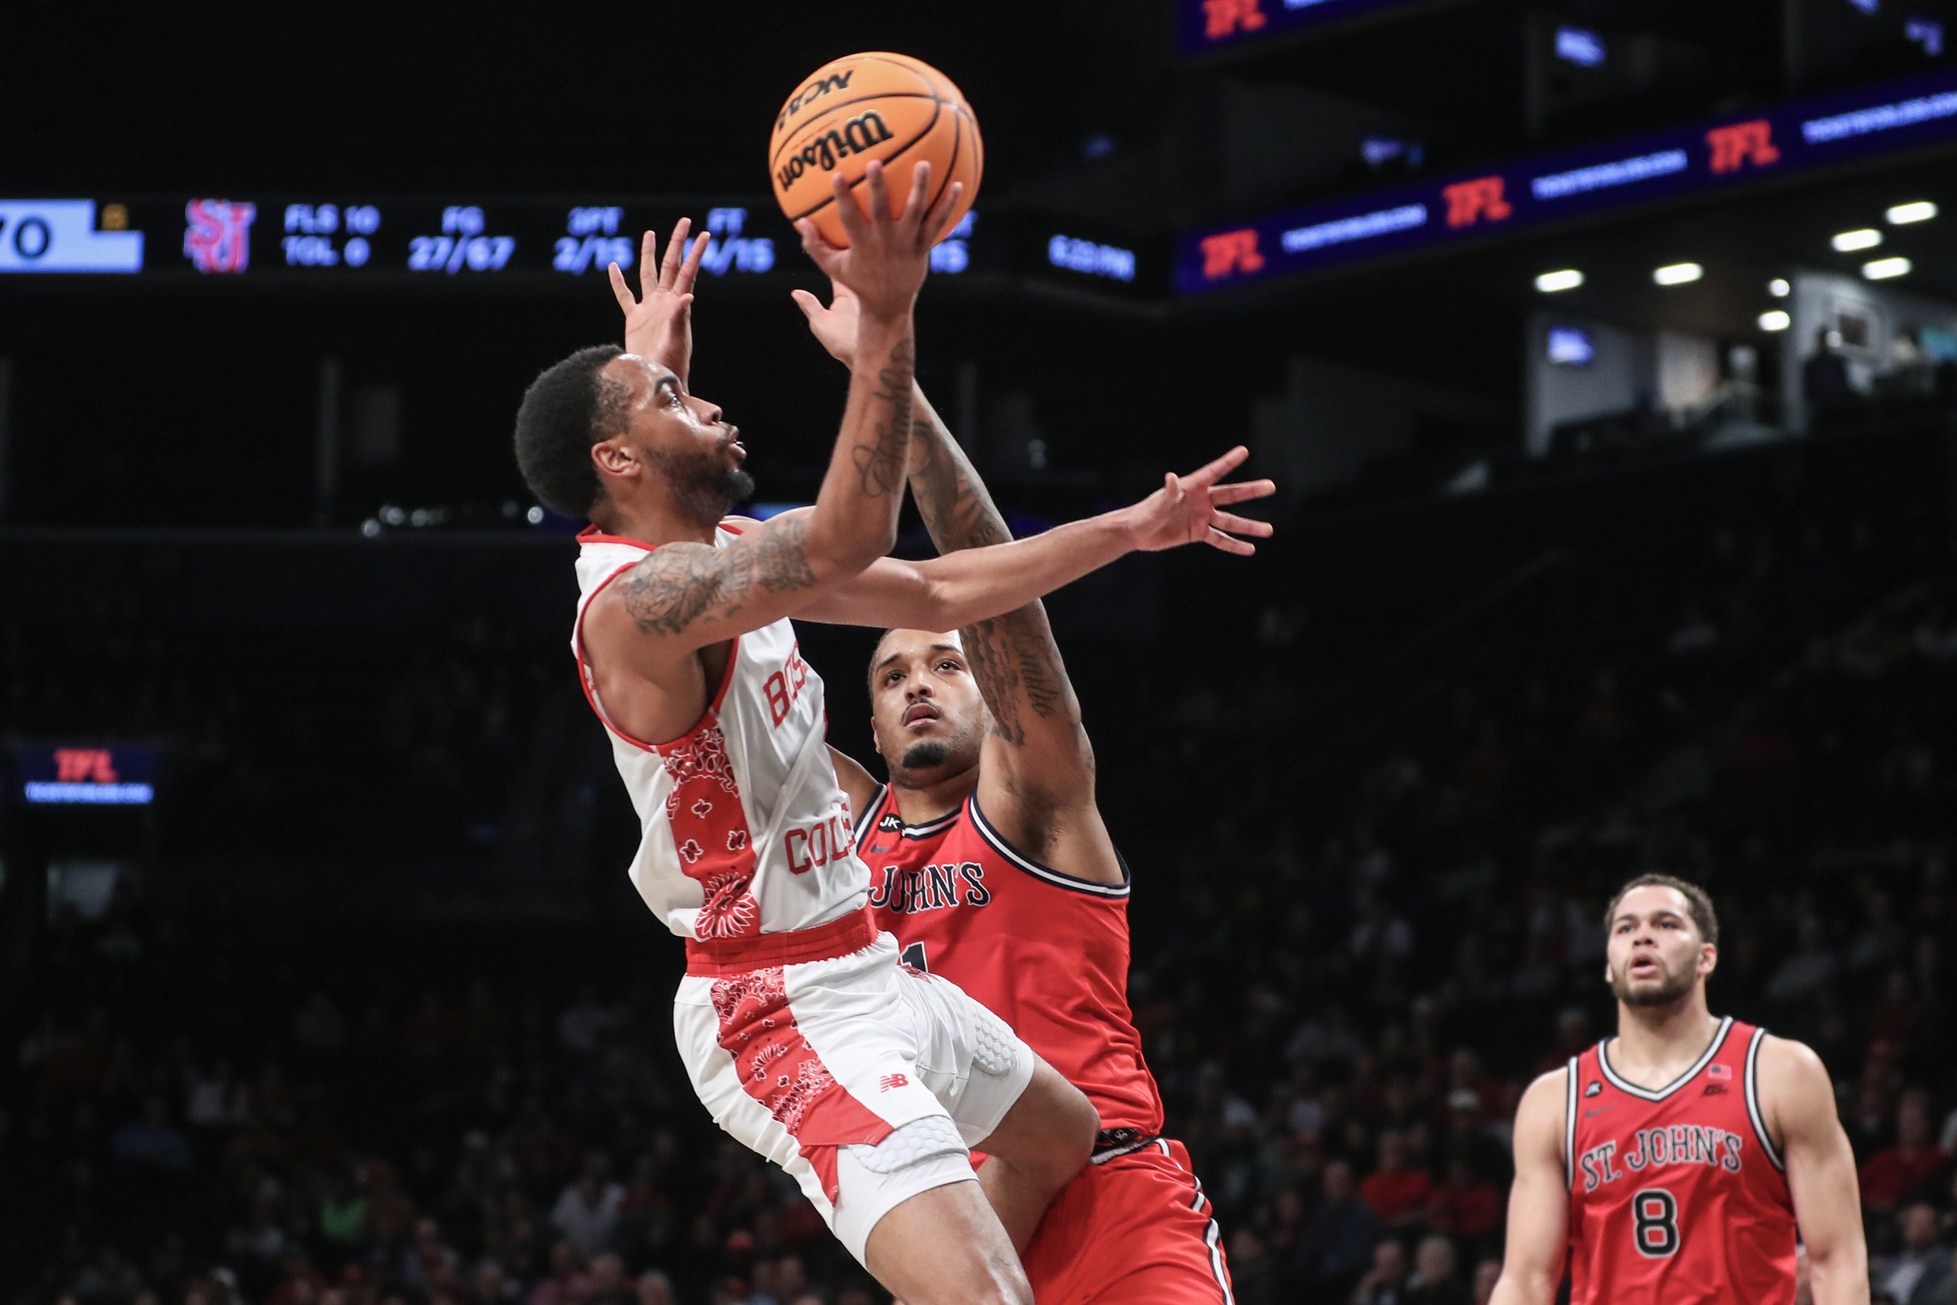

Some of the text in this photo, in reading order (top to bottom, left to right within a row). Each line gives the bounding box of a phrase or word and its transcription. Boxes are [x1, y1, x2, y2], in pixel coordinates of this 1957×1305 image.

[777, 110, 893, 192] Wilson
[0, 216, 49, 259] 0
[344, 206, 380, 234] 10
[442, 206, 484, 234] FG
[567, 207, 623, 236] 3PT
[707, 208, 747, 236] FT
[344, 237, 370, 267] 0
[408, 235, 515, 274] 27/67
[553, 235, 633, 274] 2/15
[880, 816, 901, 829] JK
[868, 861, 991, 914] JOHN'S
[1580, 1124, 1742, 1193] ST. JOHN'S
[1632, 1187, 1681, 1259] 8
